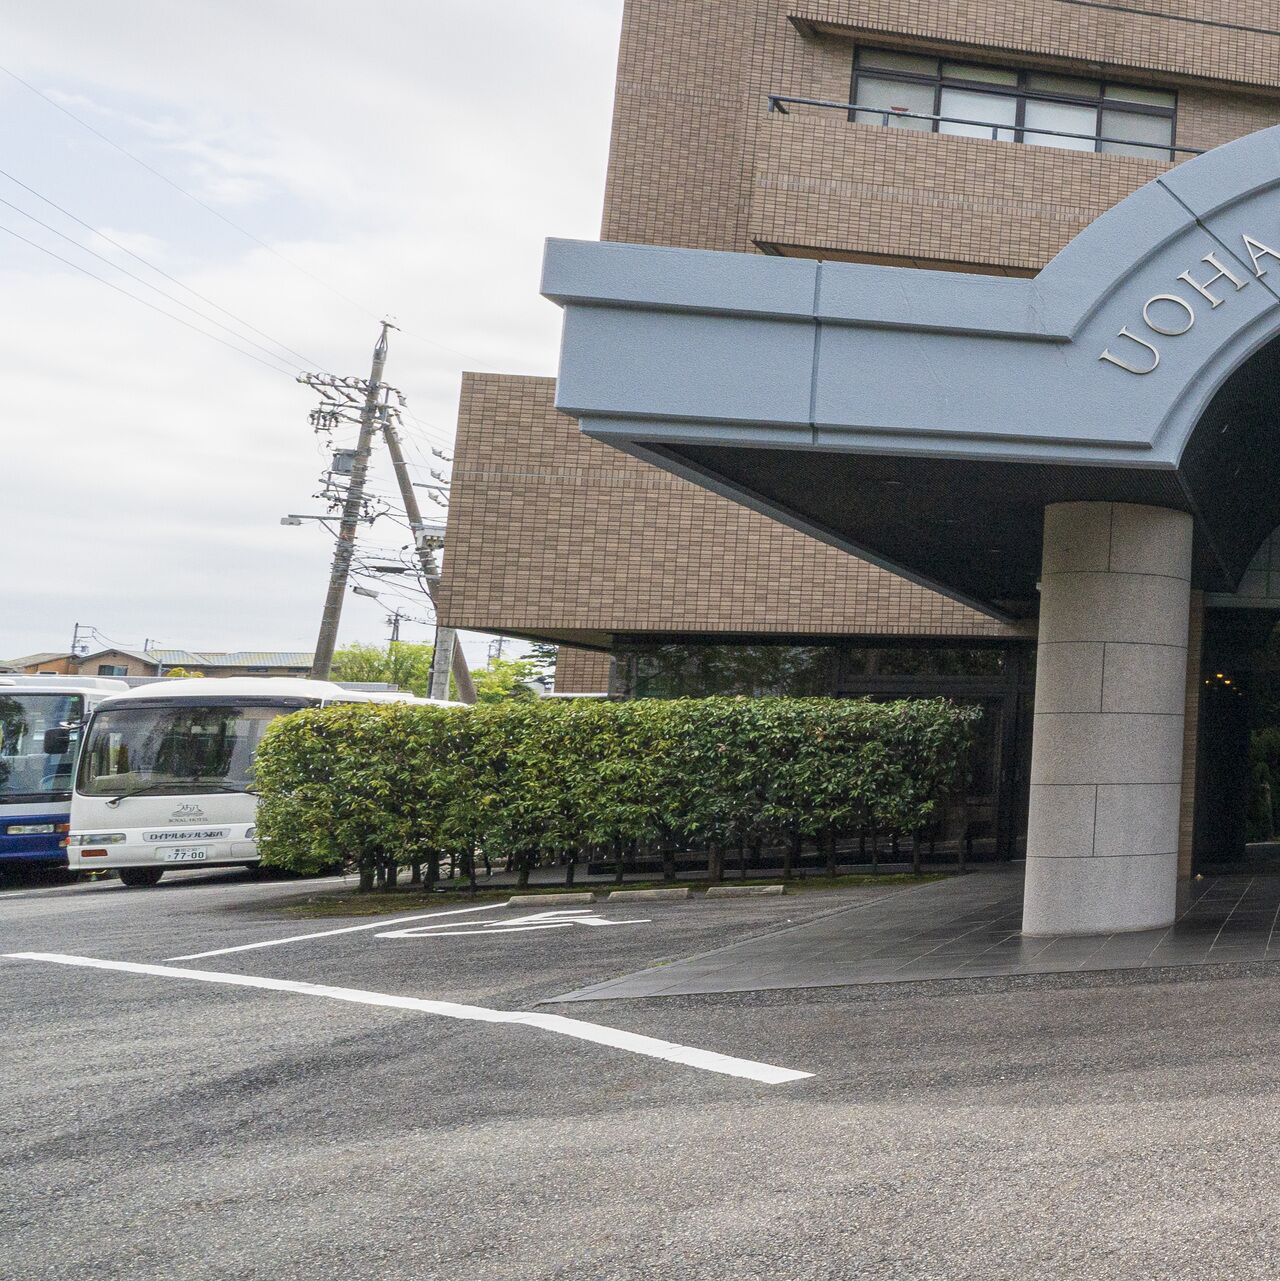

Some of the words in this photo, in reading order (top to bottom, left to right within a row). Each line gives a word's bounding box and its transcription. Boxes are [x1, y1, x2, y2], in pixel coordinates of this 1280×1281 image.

[149, 831, 224, 840] ロイヤルホテルうお八
[173, 852, 204, 860] 77-00
